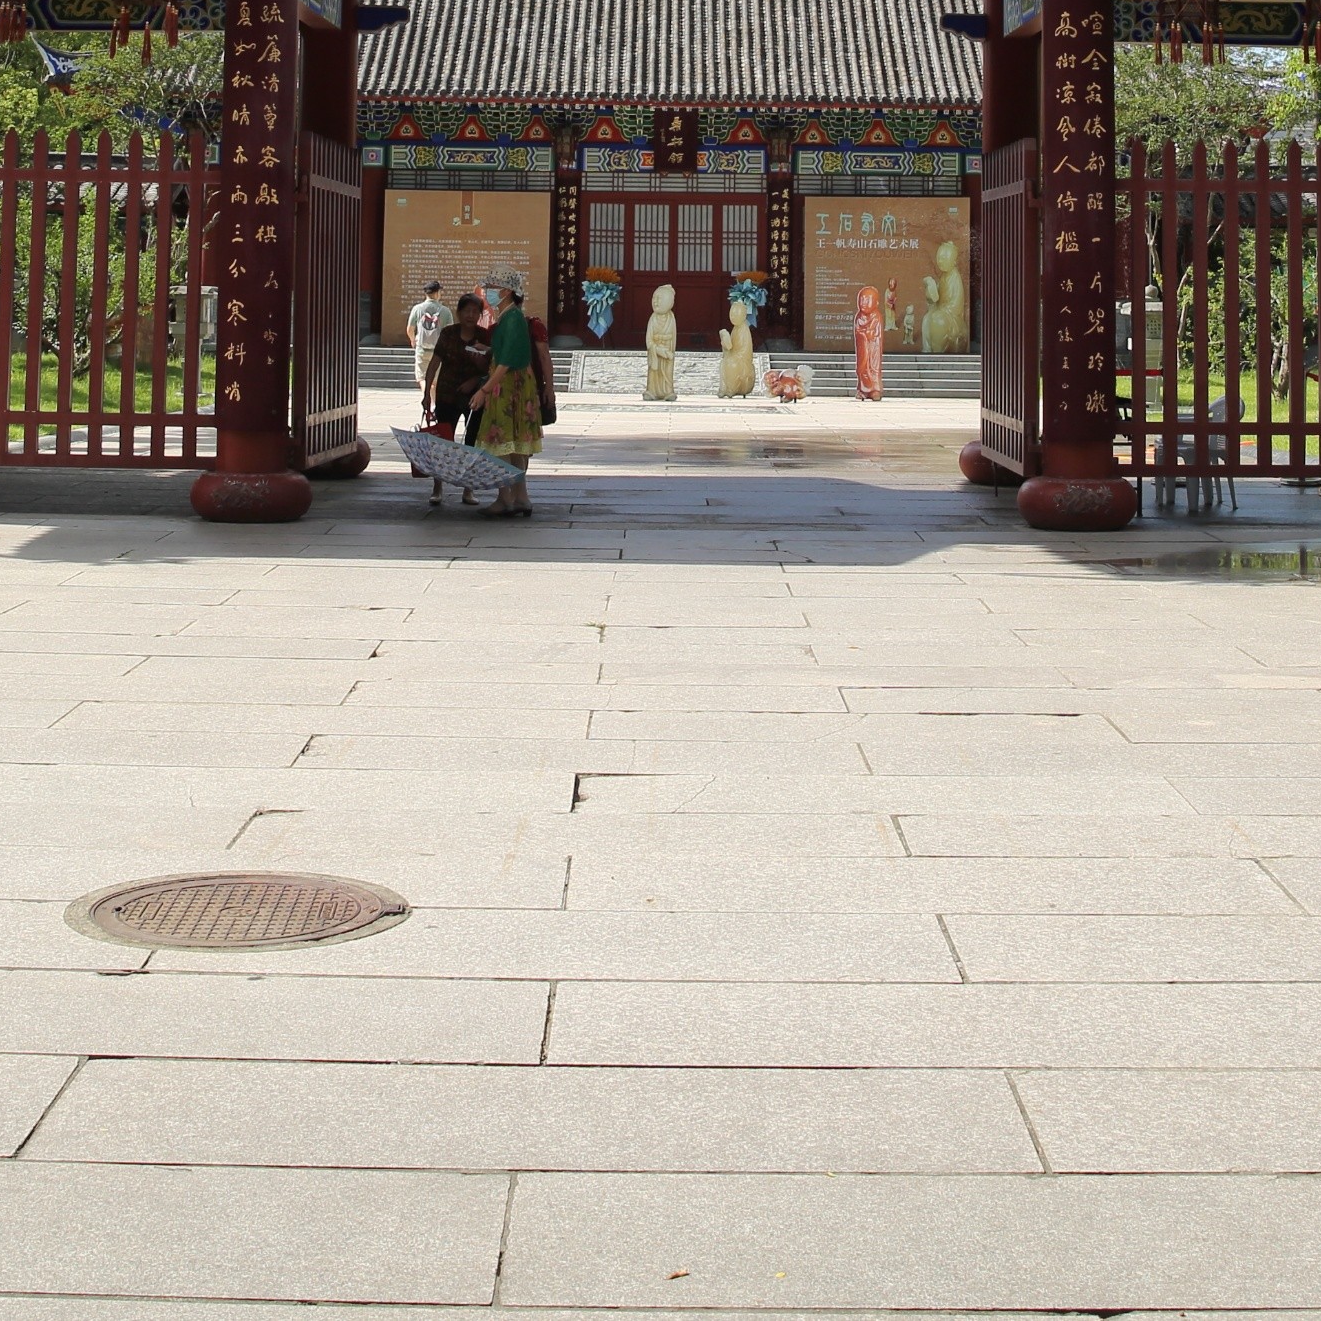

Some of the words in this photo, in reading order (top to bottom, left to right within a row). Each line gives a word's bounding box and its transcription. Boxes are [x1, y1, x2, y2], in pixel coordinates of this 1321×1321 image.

[816, 238, 919, 249] 王一帆寿山石雕艺术展
